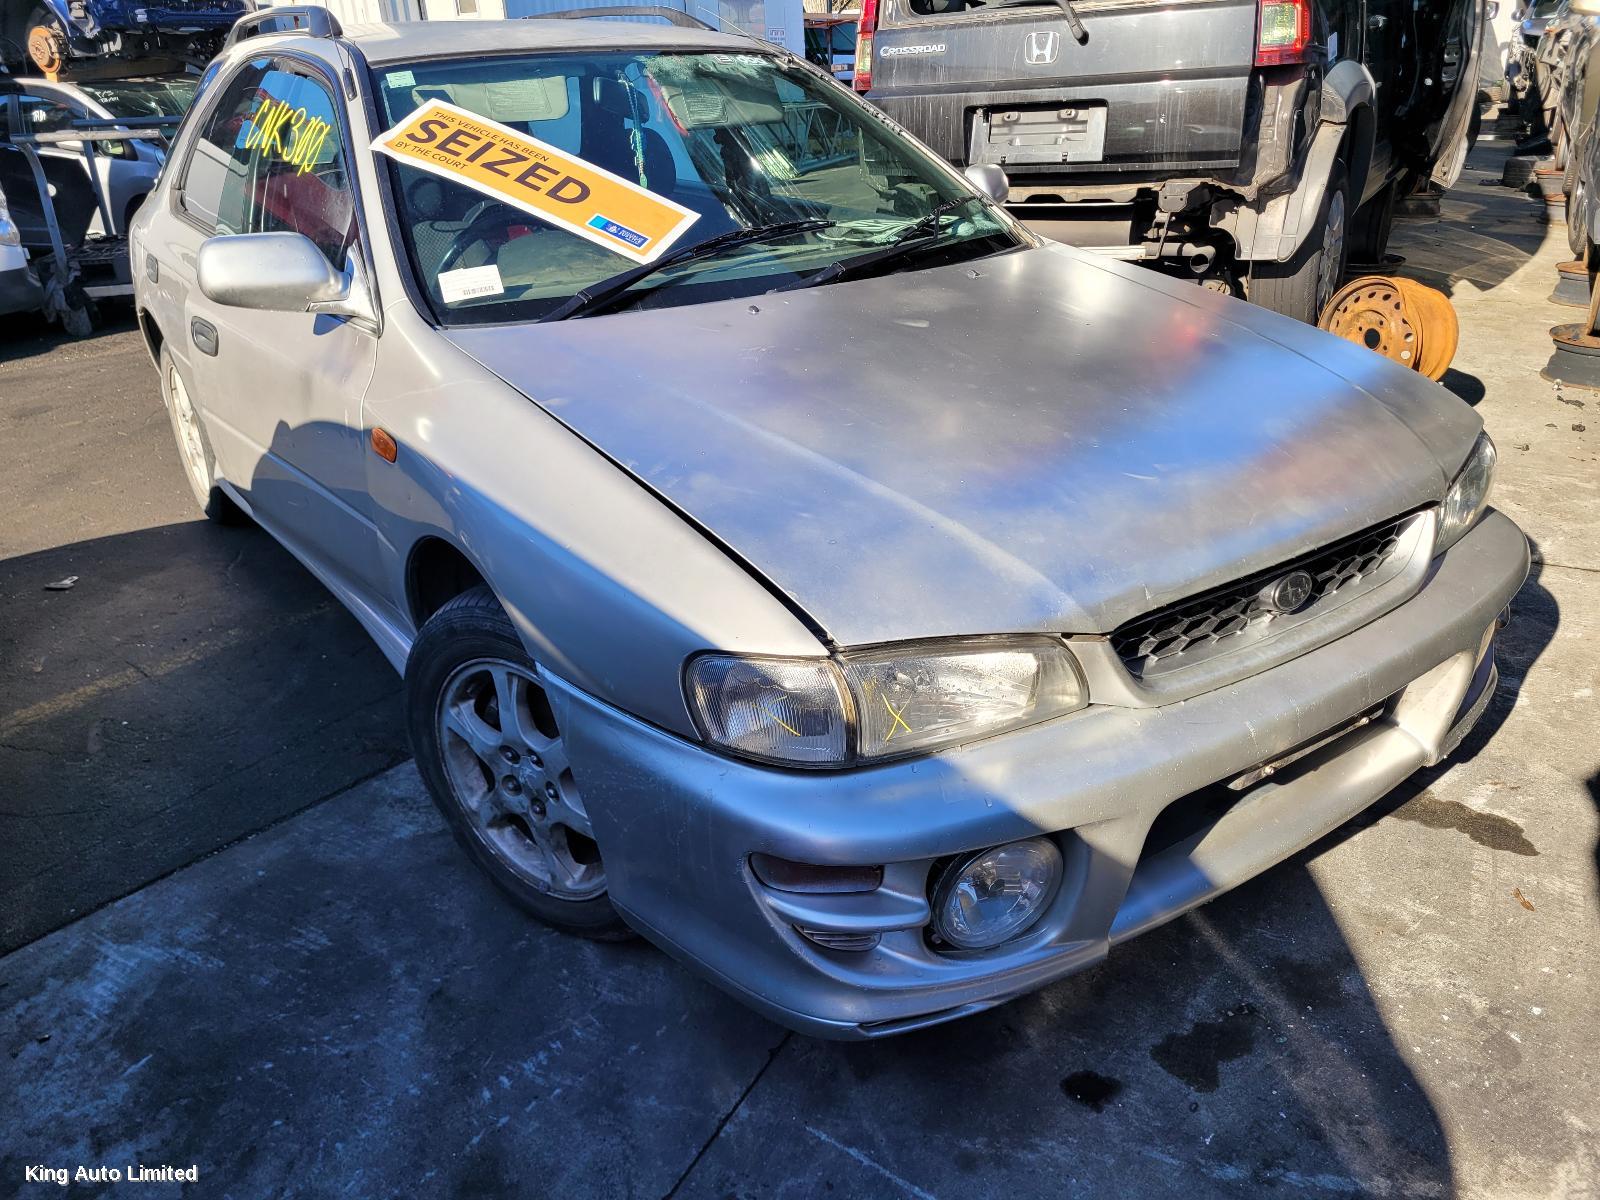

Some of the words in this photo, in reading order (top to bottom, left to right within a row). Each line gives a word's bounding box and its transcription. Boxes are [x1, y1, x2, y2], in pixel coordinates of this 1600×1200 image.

[879, 44, 946, 57] CROSSROAD
[395, 141, 410, 149] BY
[411, 145, 432, 156] THE
[431, 153, 469, 170] COURT
[434, 111, 456, 123] THIS
[458, 120, 499, 140] VEHICLE
[499, 137, 520, 150] HAS
[521, 147, 550, 162] BEEN
[405, 119, 591, 204] SEIZED
